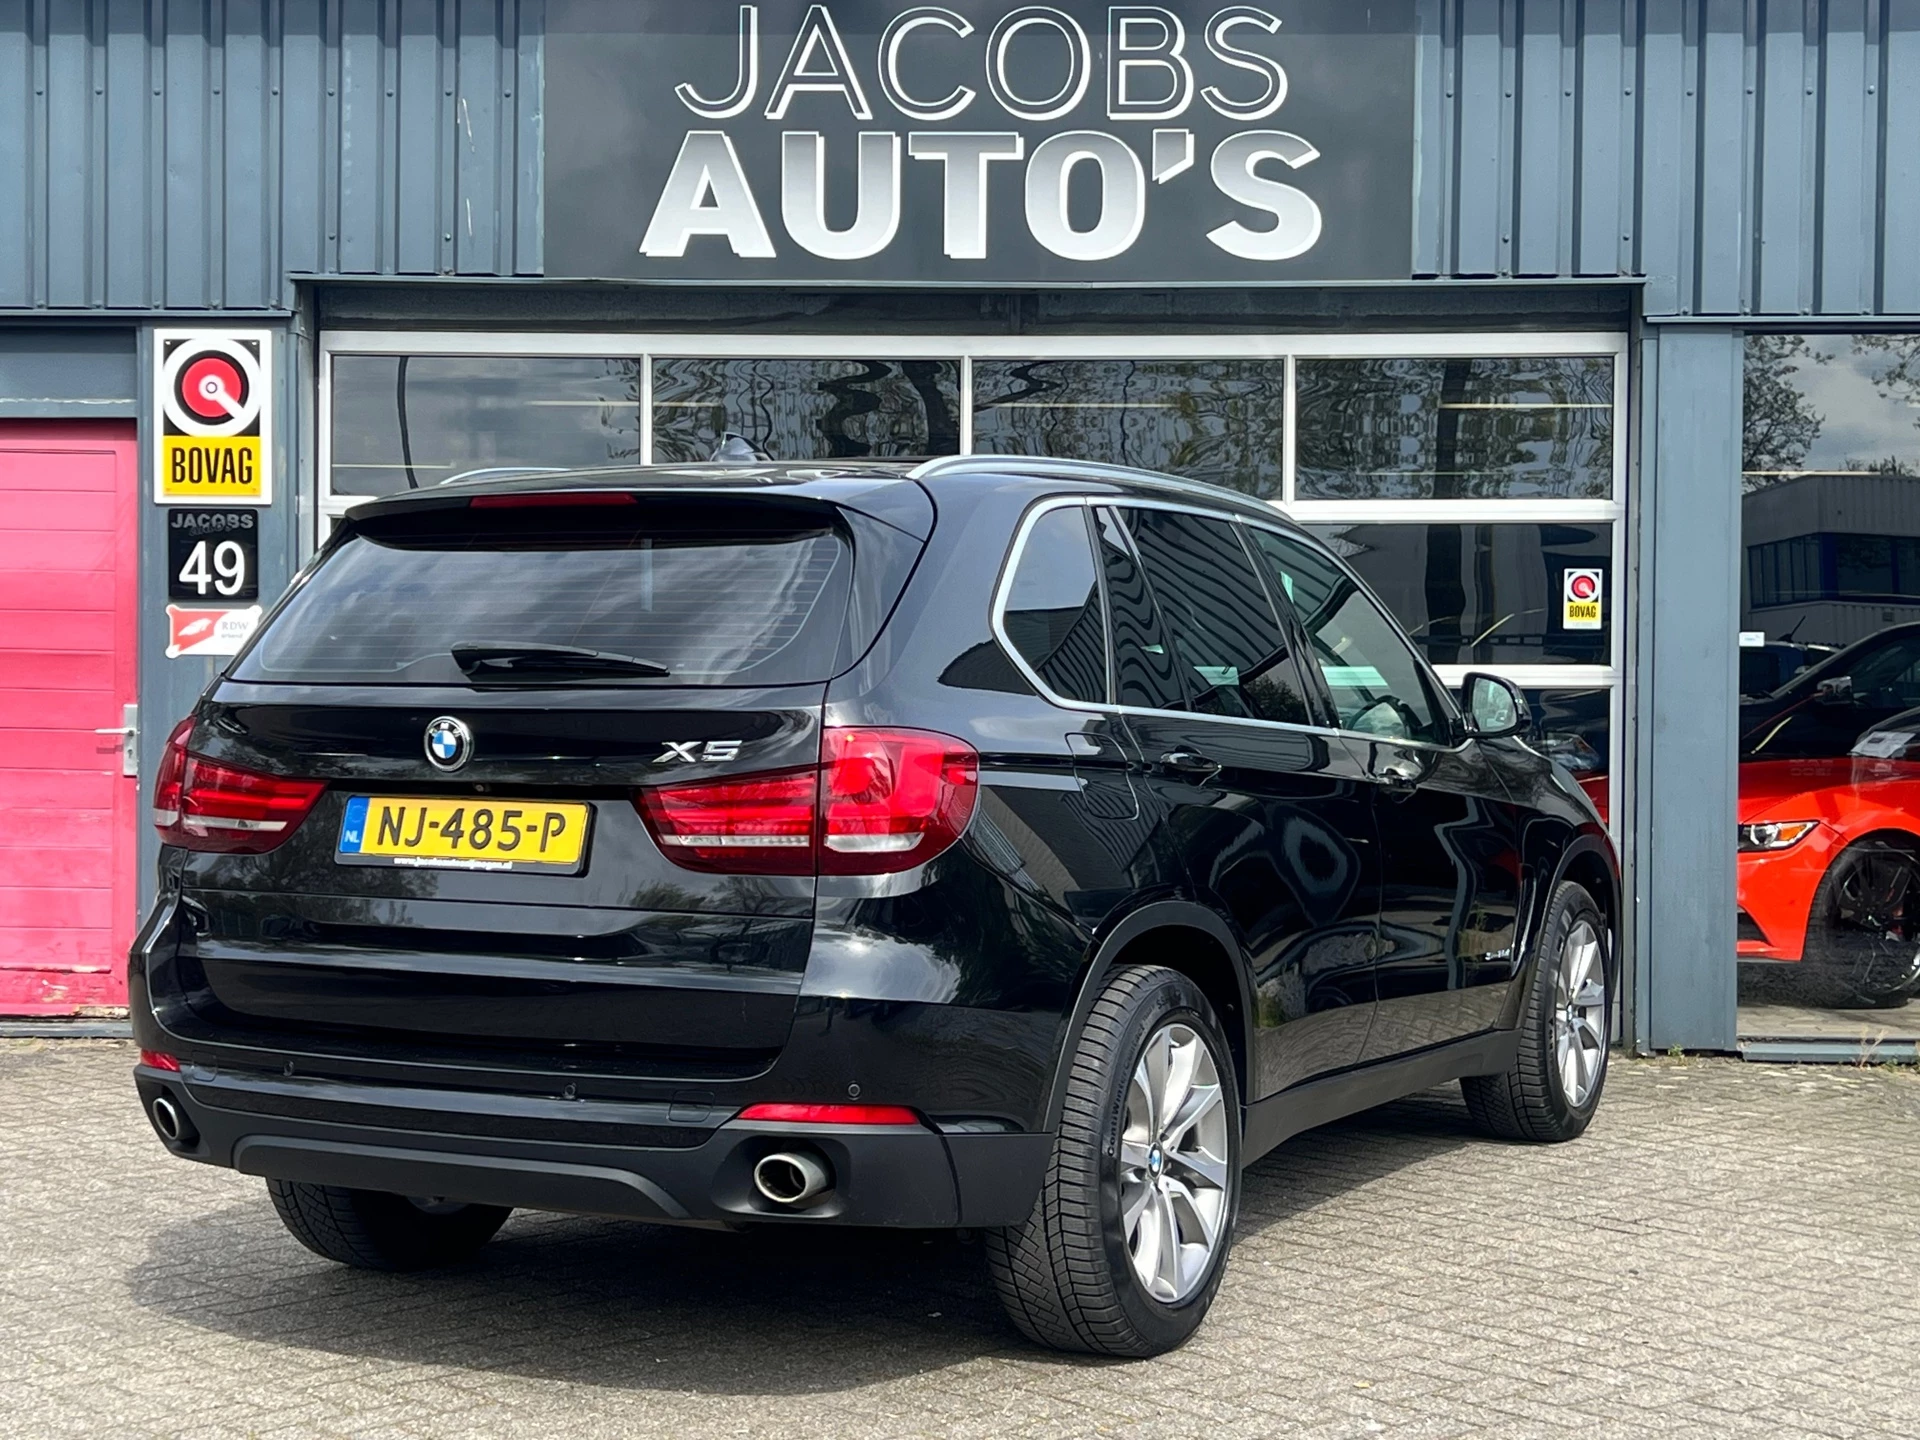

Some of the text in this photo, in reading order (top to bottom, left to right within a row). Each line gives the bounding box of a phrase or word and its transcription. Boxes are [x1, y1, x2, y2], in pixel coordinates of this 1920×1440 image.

[675, 5, 1288, 120] JACOBS
[639, 129, 1322, 261] AUTO'S
[171, 446, 253, 484] BOVAG
[170, 513, 254, 529] JACOBS
[179, 540, 245, 595] 49
[222, 621, 249, 630] RDW
[1569, 605, 1597, 618] BOVAG
[651, 740, 742, 763] X5
[344, 831, 360, 844] NL
[376, 806, 566, 853] NJ-485-P
